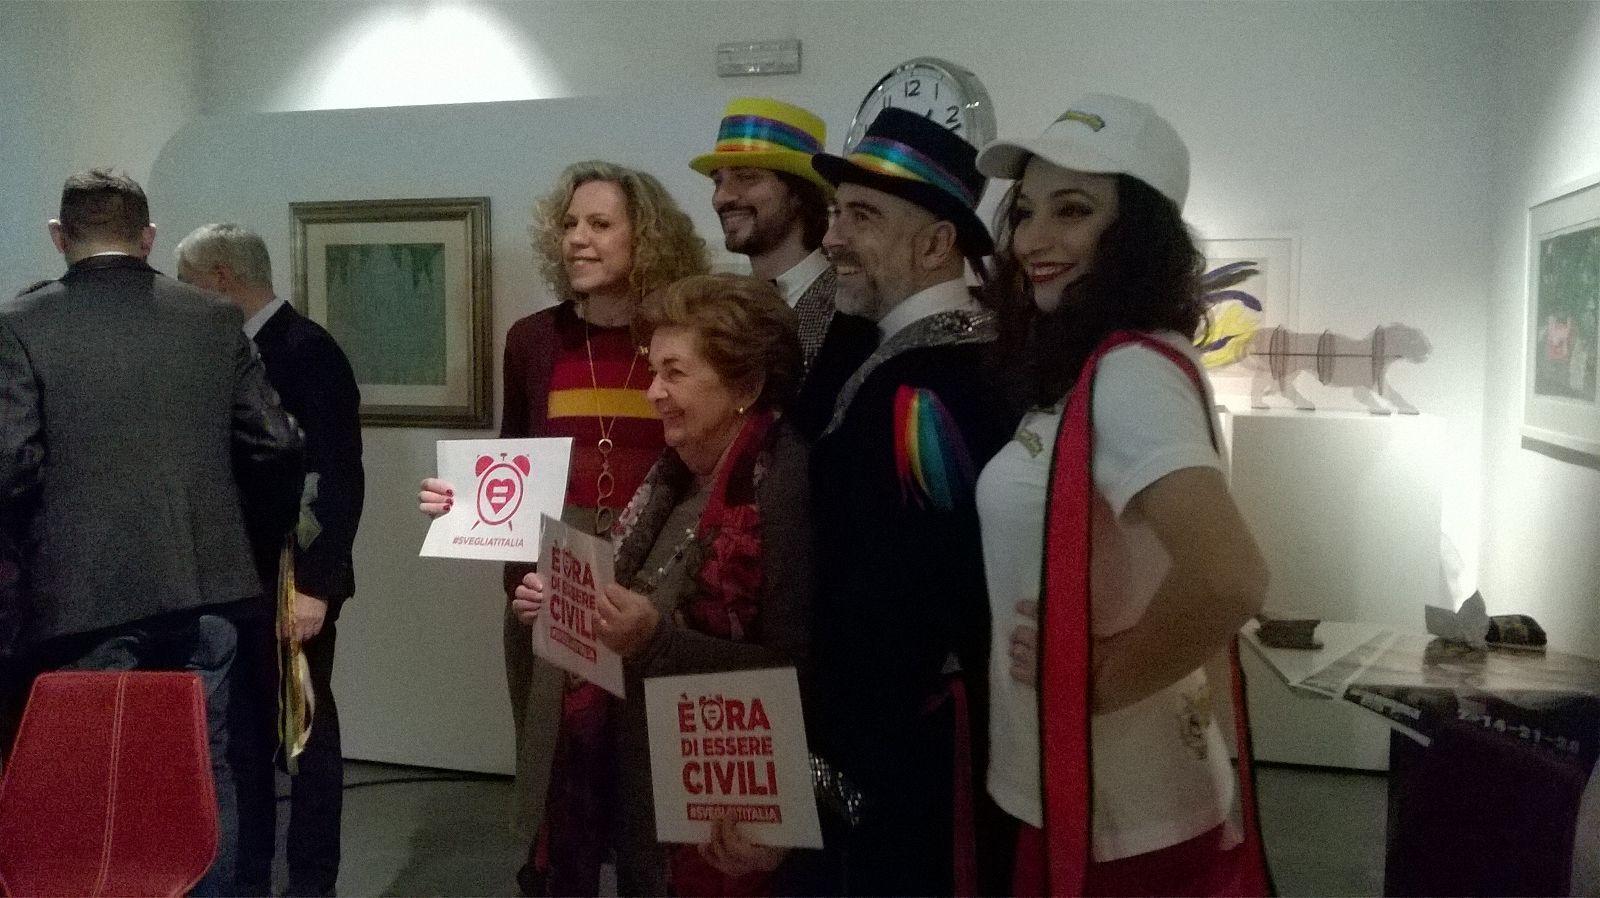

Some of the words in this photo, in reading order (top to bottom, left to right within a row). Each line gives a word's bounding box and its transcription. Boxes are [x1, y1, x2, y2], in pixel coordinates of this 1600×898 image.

[904, 79, 921, 98] 12
[945, 104, 960, 123] 2
[452, 536, 524, 548] #SVEGLIATITALIA
[551, 574, 560, 590] DI
[562, 582, 596, 611] ESSERE
[678, 692, 696, 732] È
[681, 738, 698, 756] DI
[702, 737, 773, 757] ESSERE
[683, 761, 778, 795] CIVILI
